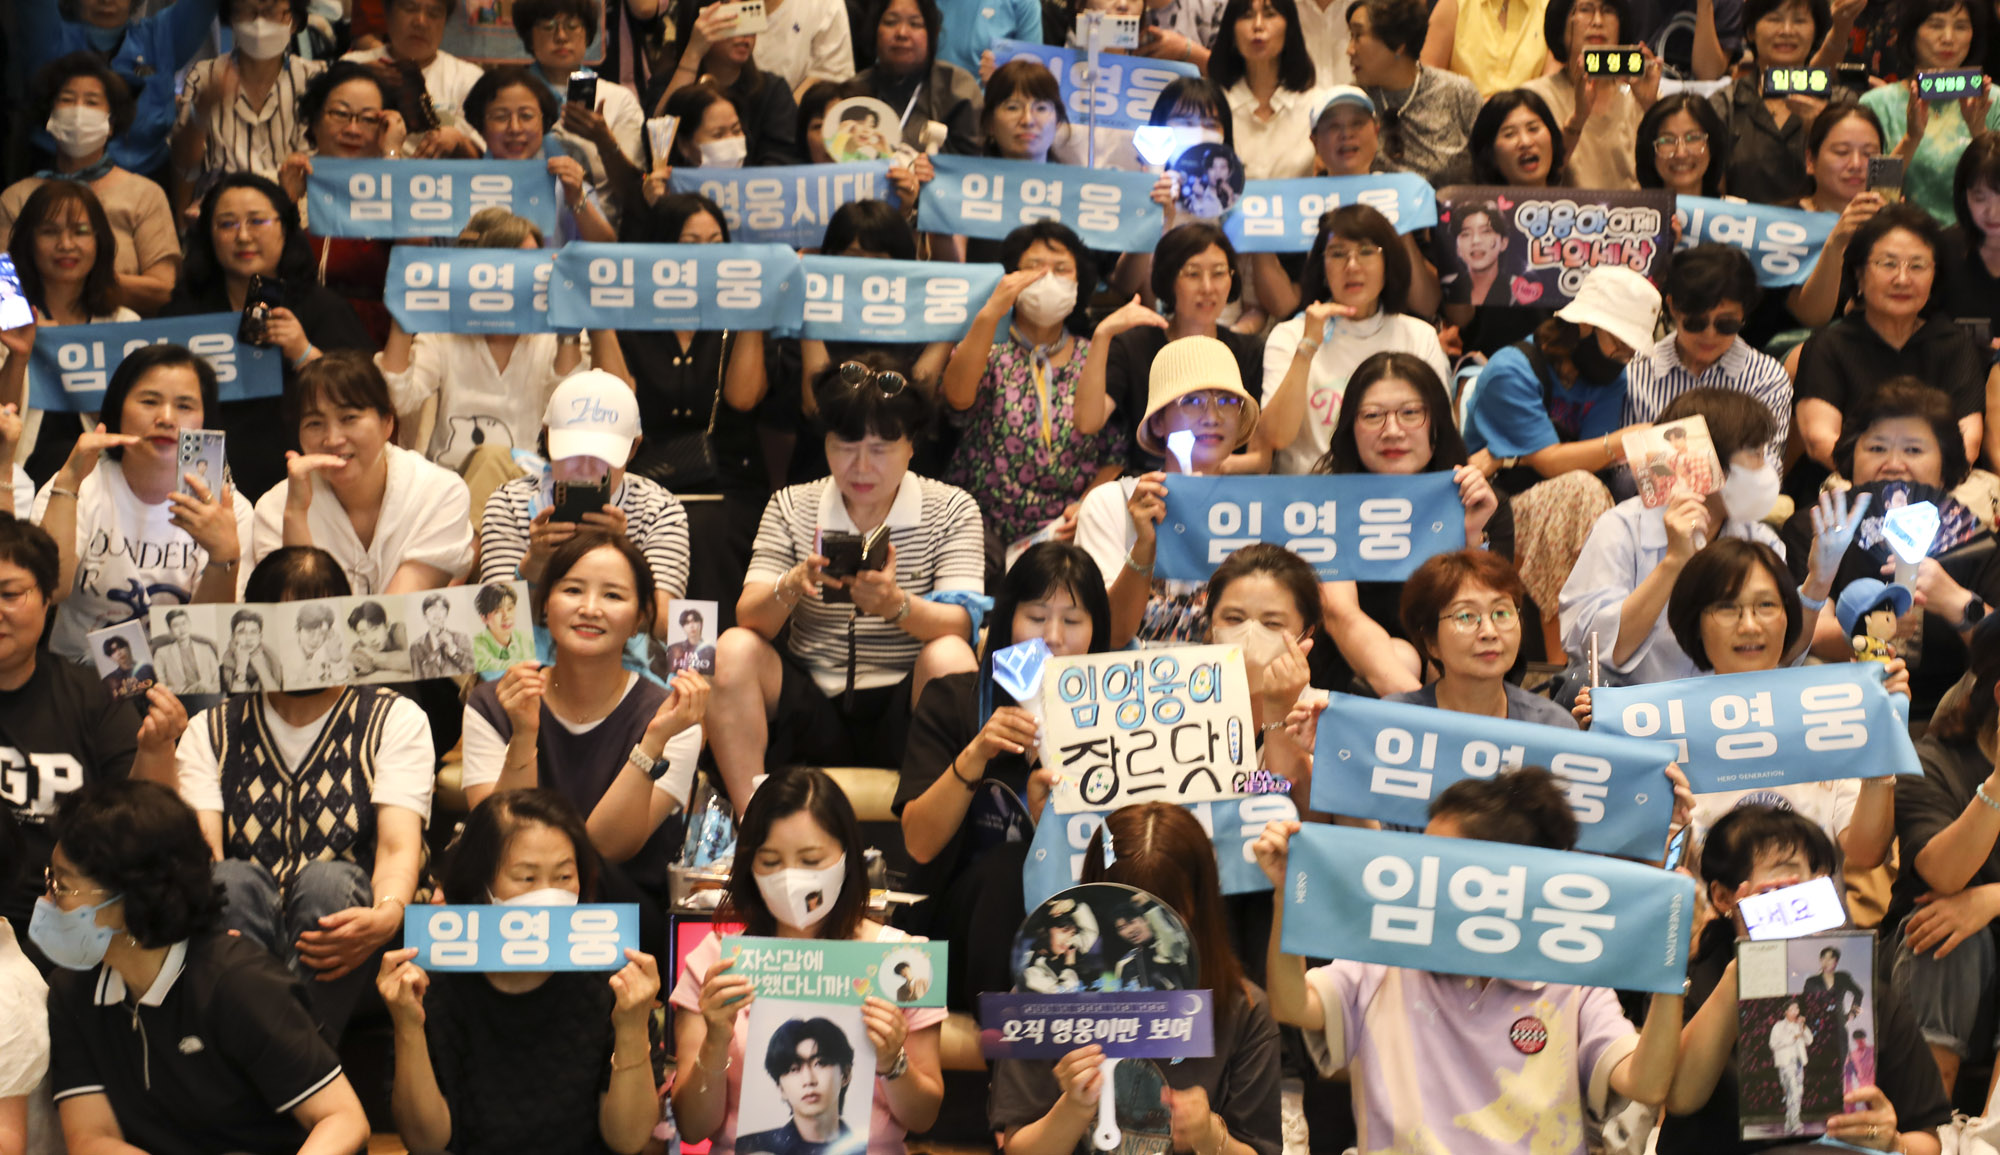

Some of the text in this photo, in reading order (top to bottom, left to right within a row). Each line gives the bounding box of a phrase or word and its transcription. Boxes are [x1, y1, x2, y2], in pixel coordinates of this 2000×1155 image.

[1058, 656, 1221, 730] 임영웅이
[428, 910, 620, 966] 임영웅
[1362, 855, 1615, 964] 임영웅
[1000, 1016, 1194, 1045] 오직 영웅이만 보여
